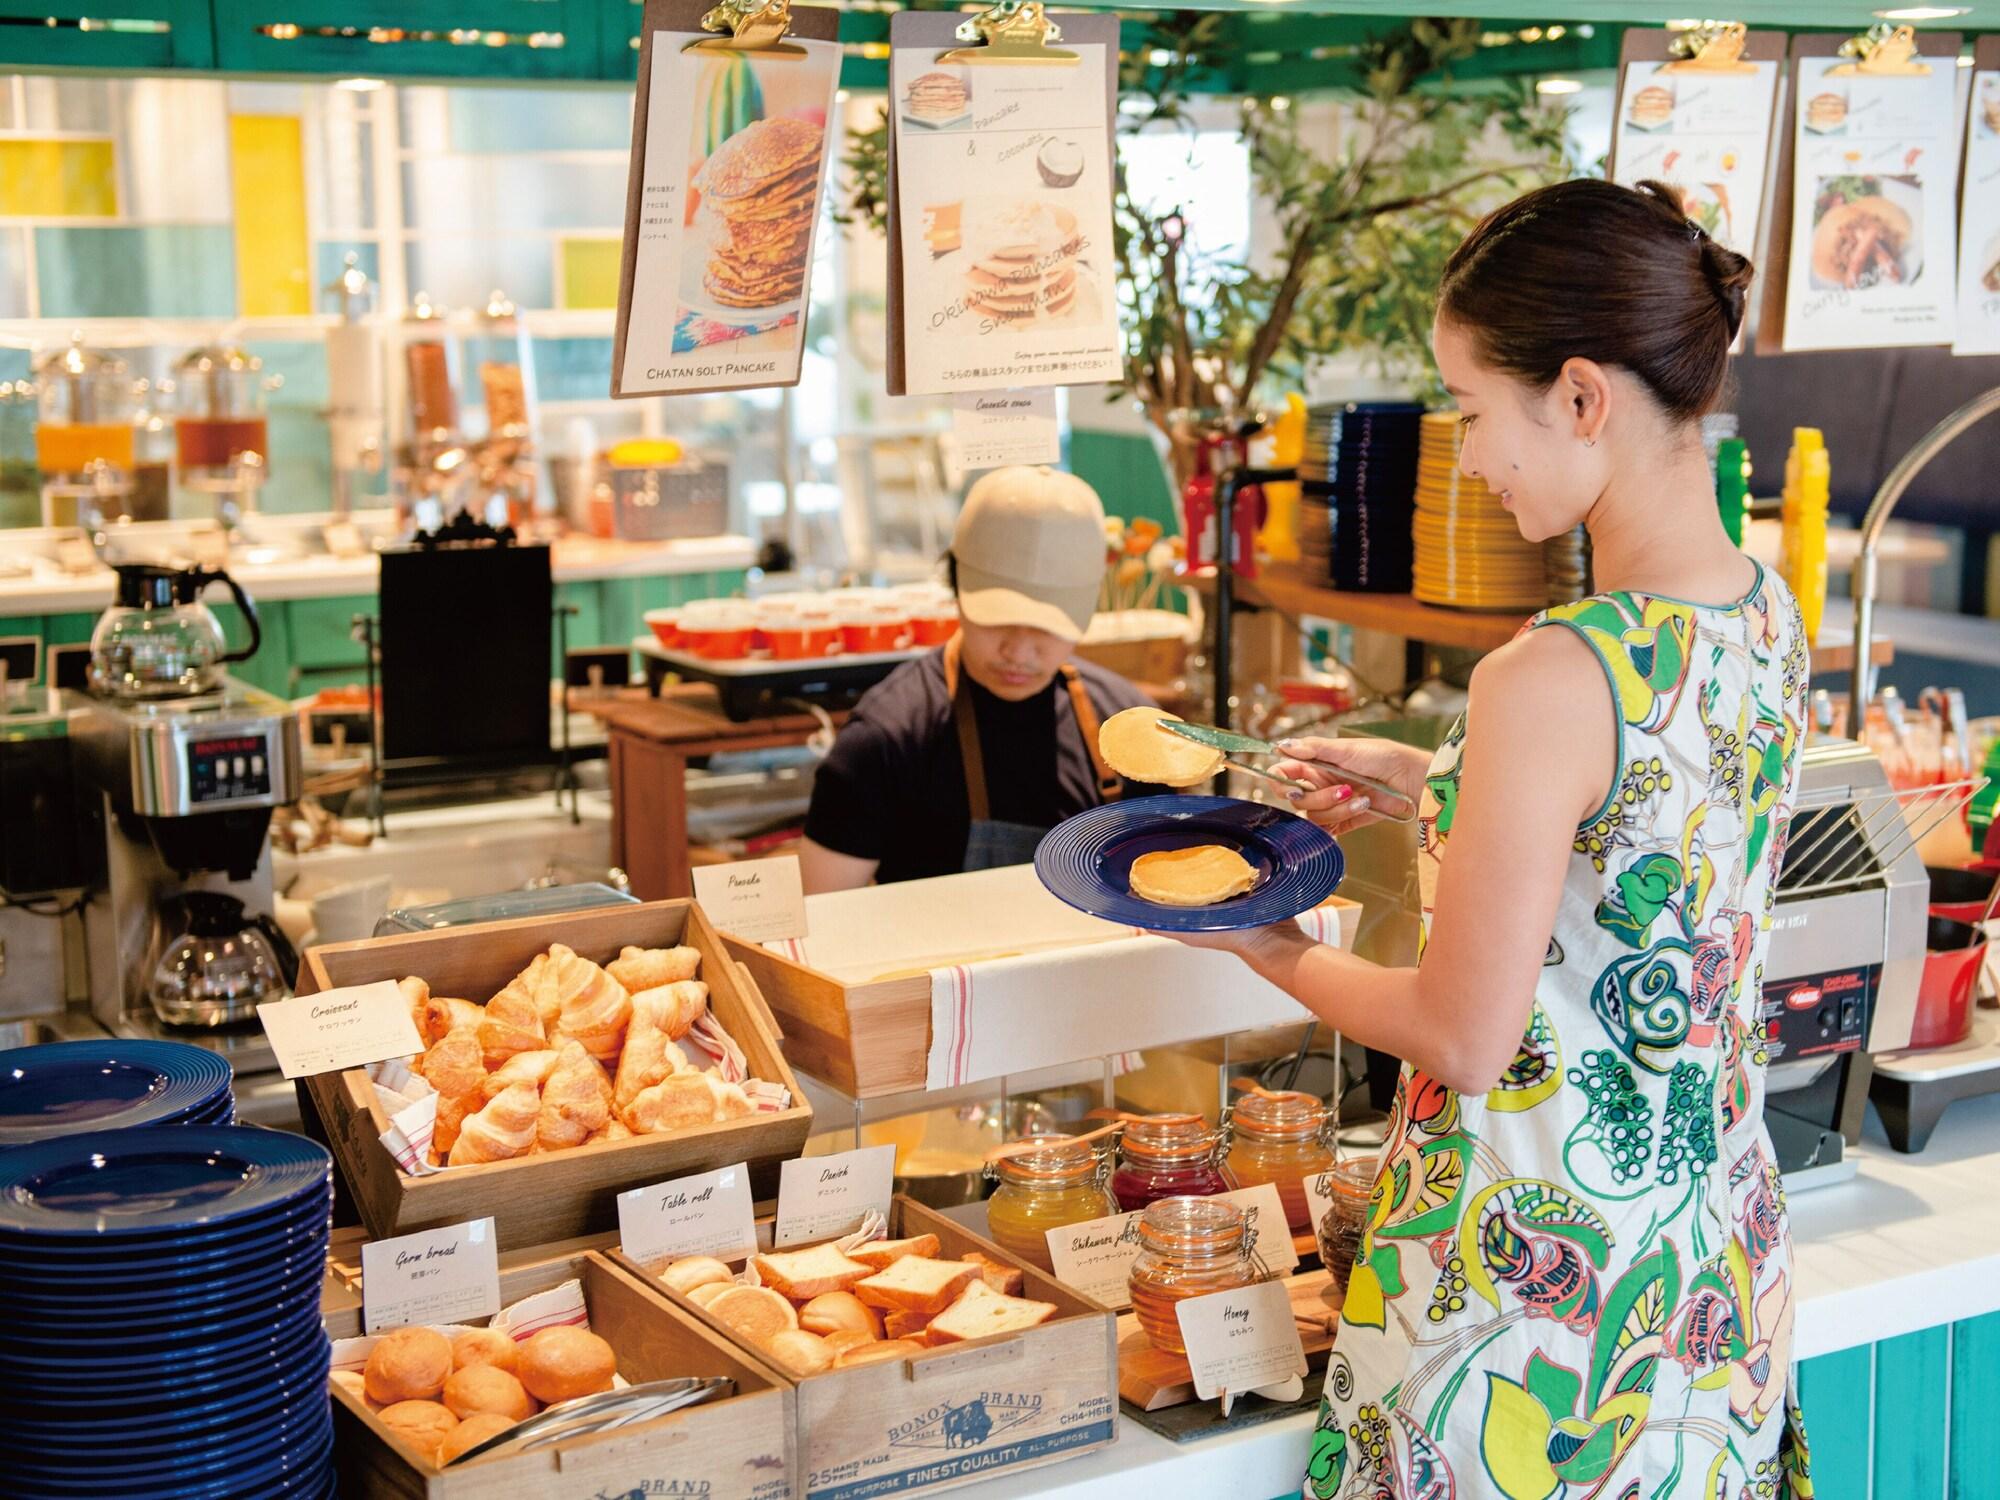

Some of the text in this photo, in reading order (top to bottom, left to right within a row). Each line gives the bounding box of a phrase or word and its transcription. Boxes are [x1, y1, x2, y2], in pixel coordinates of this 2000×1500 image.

[646, 367, 694, 380] CHATAN
[724, 361, 776, 375] PANCAKE
[311, 1000, 359, 1019] Croissant
[820, 1166, 849, 1182] Danish
[661, 1186, 713, 1212] Table roll
[395, 1241, 458, 1270] Germ bread
[1224, 1305, 1250, 1322] Honey
[1229, 1326, 1255, 1338] はちみつ
[887, 1391, 1043, 1442] BONOX BRAND
[832, 1454, 891, 1474] HAND MADE
[853, 1478, 901, 1497] PURPOSE
[907, 1460, 960, 1486] FINEST
[961, 1446, 1022, 1473] QUALITY
[1046, 1431, 1091, 1449] PURPOSE
[639, 1479, 711, 1493] BRAND
